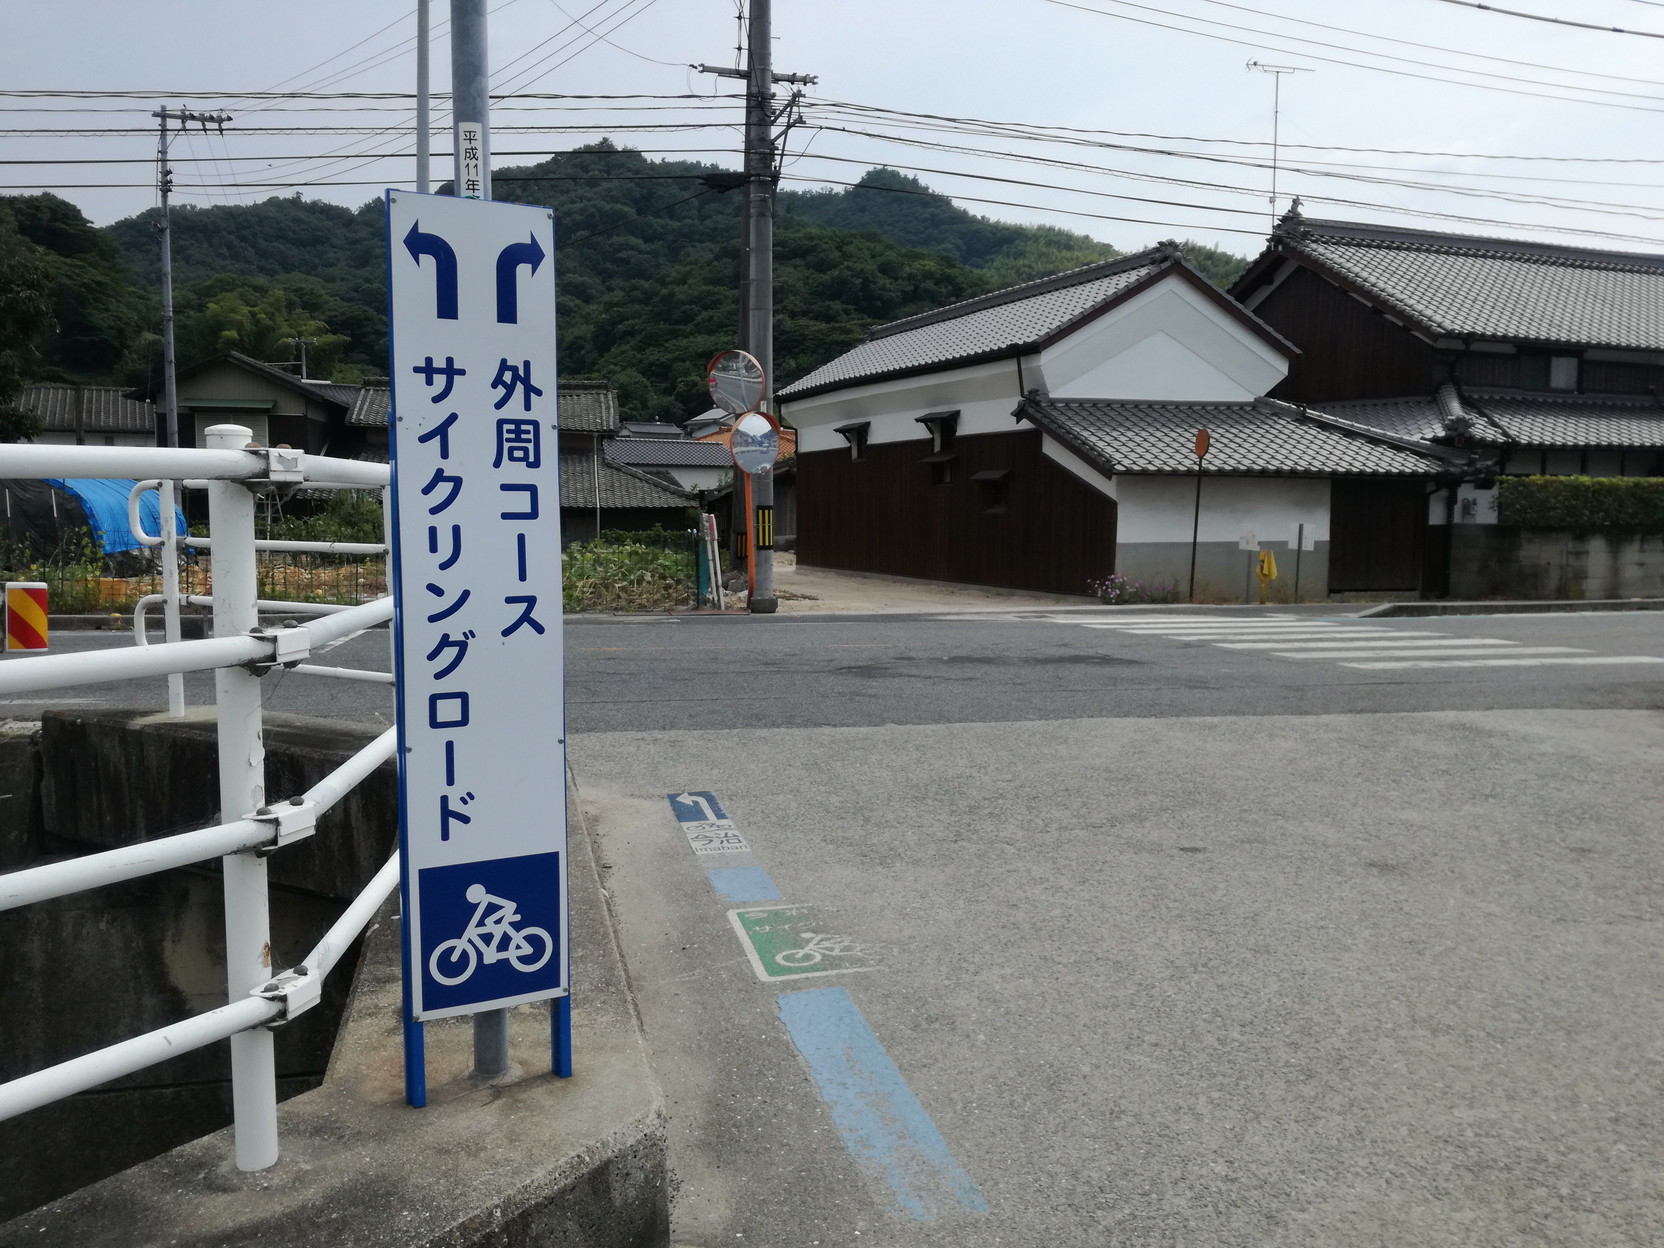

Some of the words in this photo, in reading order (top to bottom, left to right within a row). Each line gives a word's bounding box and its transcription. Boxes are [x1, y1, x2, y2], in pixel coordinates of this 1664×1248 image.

[463, 130, 481, 199] 平成11年
[490, 358, 546, 638] 外周コース
[412, 356, 477, 842] サイクリングロード
[690, 831, 743, 846] 今治
[694, 844, 749, 853] Imabari
